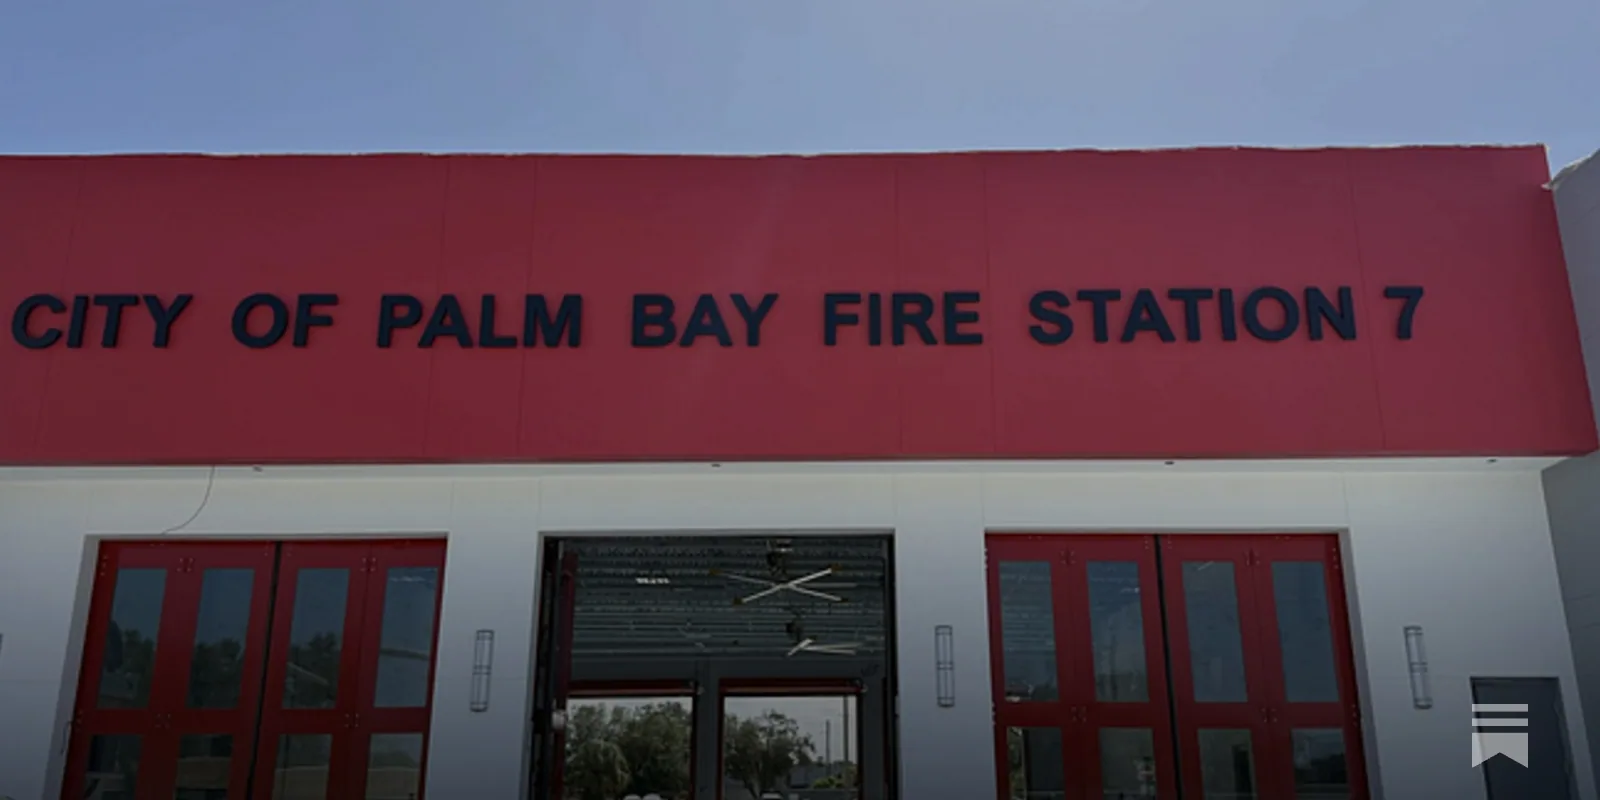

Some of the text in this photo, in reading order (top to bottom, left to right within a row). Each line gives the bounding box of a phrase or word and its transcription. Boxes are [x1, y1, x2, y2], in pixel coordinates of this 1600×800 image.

[11, 286, 1424, 350] CITY OF PALM BAY FIRE STATION 7
